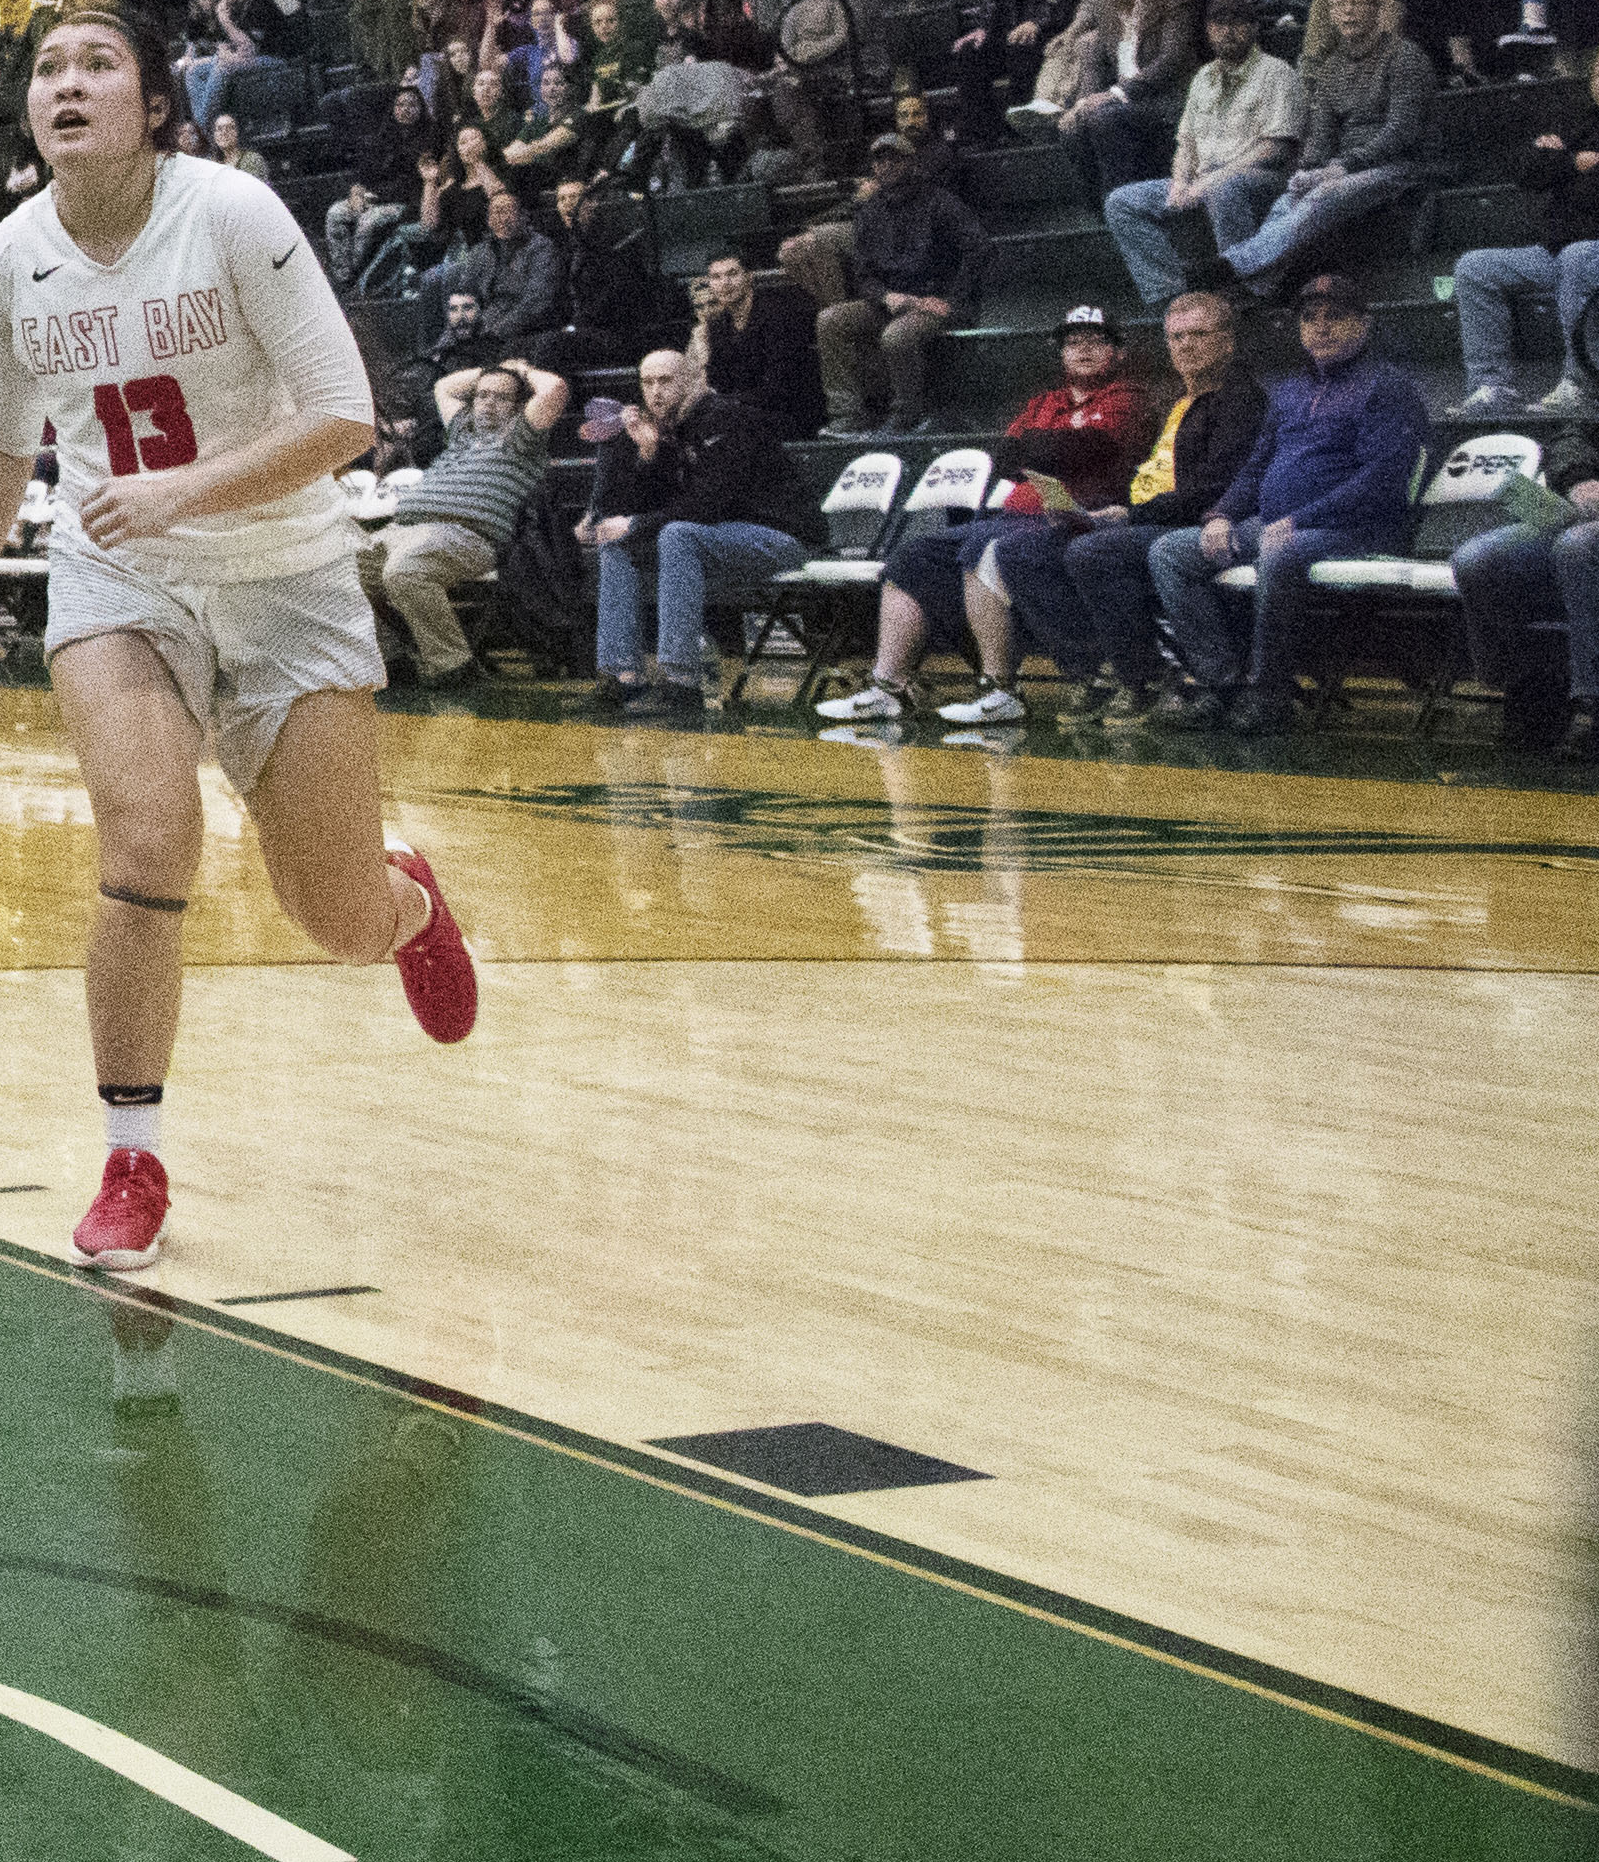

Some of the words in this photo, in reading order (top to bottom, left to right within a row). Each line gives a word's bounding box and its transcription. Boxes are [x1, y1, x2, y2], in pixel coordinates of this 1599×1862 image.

[20, 305, 120, 376] EAST
[142, 287, 228, 362] BAY
[92, 373, 199, 478] 13
